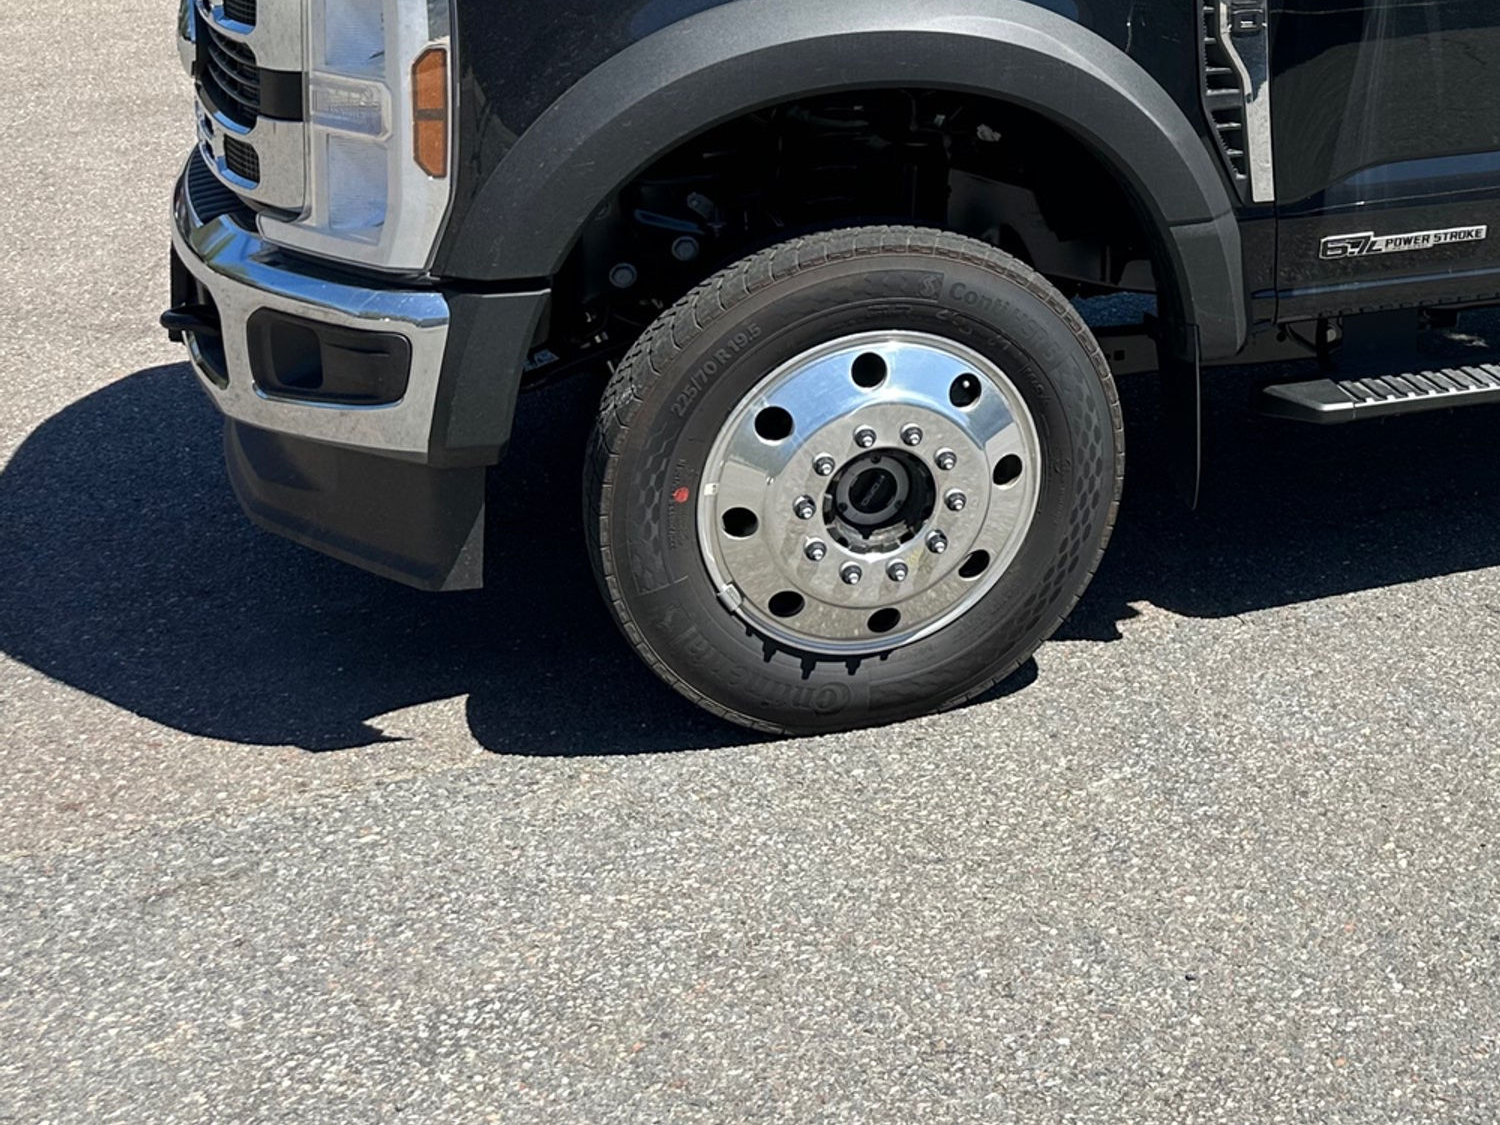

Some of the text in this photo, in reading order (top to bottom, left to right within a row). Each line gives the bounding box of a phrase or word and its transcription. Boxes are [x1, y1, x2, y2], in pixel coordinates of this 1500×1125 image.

[1320, 235, 1384, 259] 6.7L
[1384, 234, 1431, 249] POWER
[1433, 228, 1485, 244] STROKE
[949, 282, 1009, 315] Conti
[670, 323, 761, 417] 225/70 R 19.5
